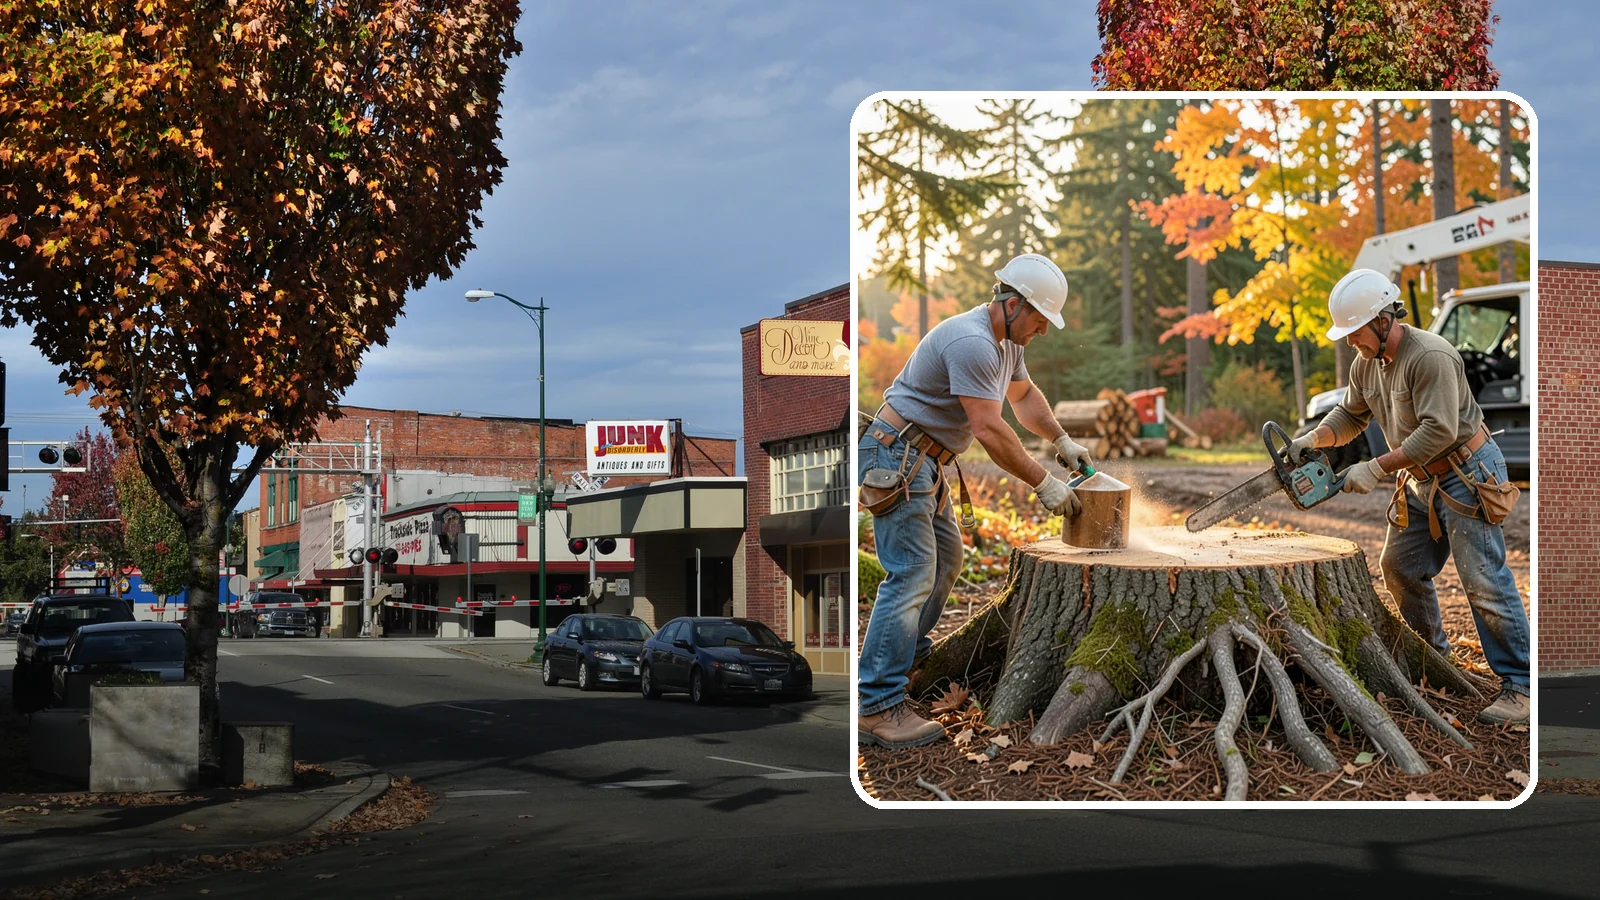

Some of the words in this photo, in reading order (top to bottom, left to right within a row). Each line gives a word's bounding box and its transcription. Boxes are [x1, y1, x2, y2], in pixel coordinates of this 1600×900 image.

[595, 425, 664, 457] JUNK
[607, 446, 645, 454] DISORDERLY
[597, 461, 628, 470] ANTIQUES
[631, 461, 644, 470] AND
[647, 460, 665, 469] GIFTS
[573, 474, 588, 490] RAIL
[352, 498, 364, 511] CRO
[414, 520, 429, 534] Pizza
